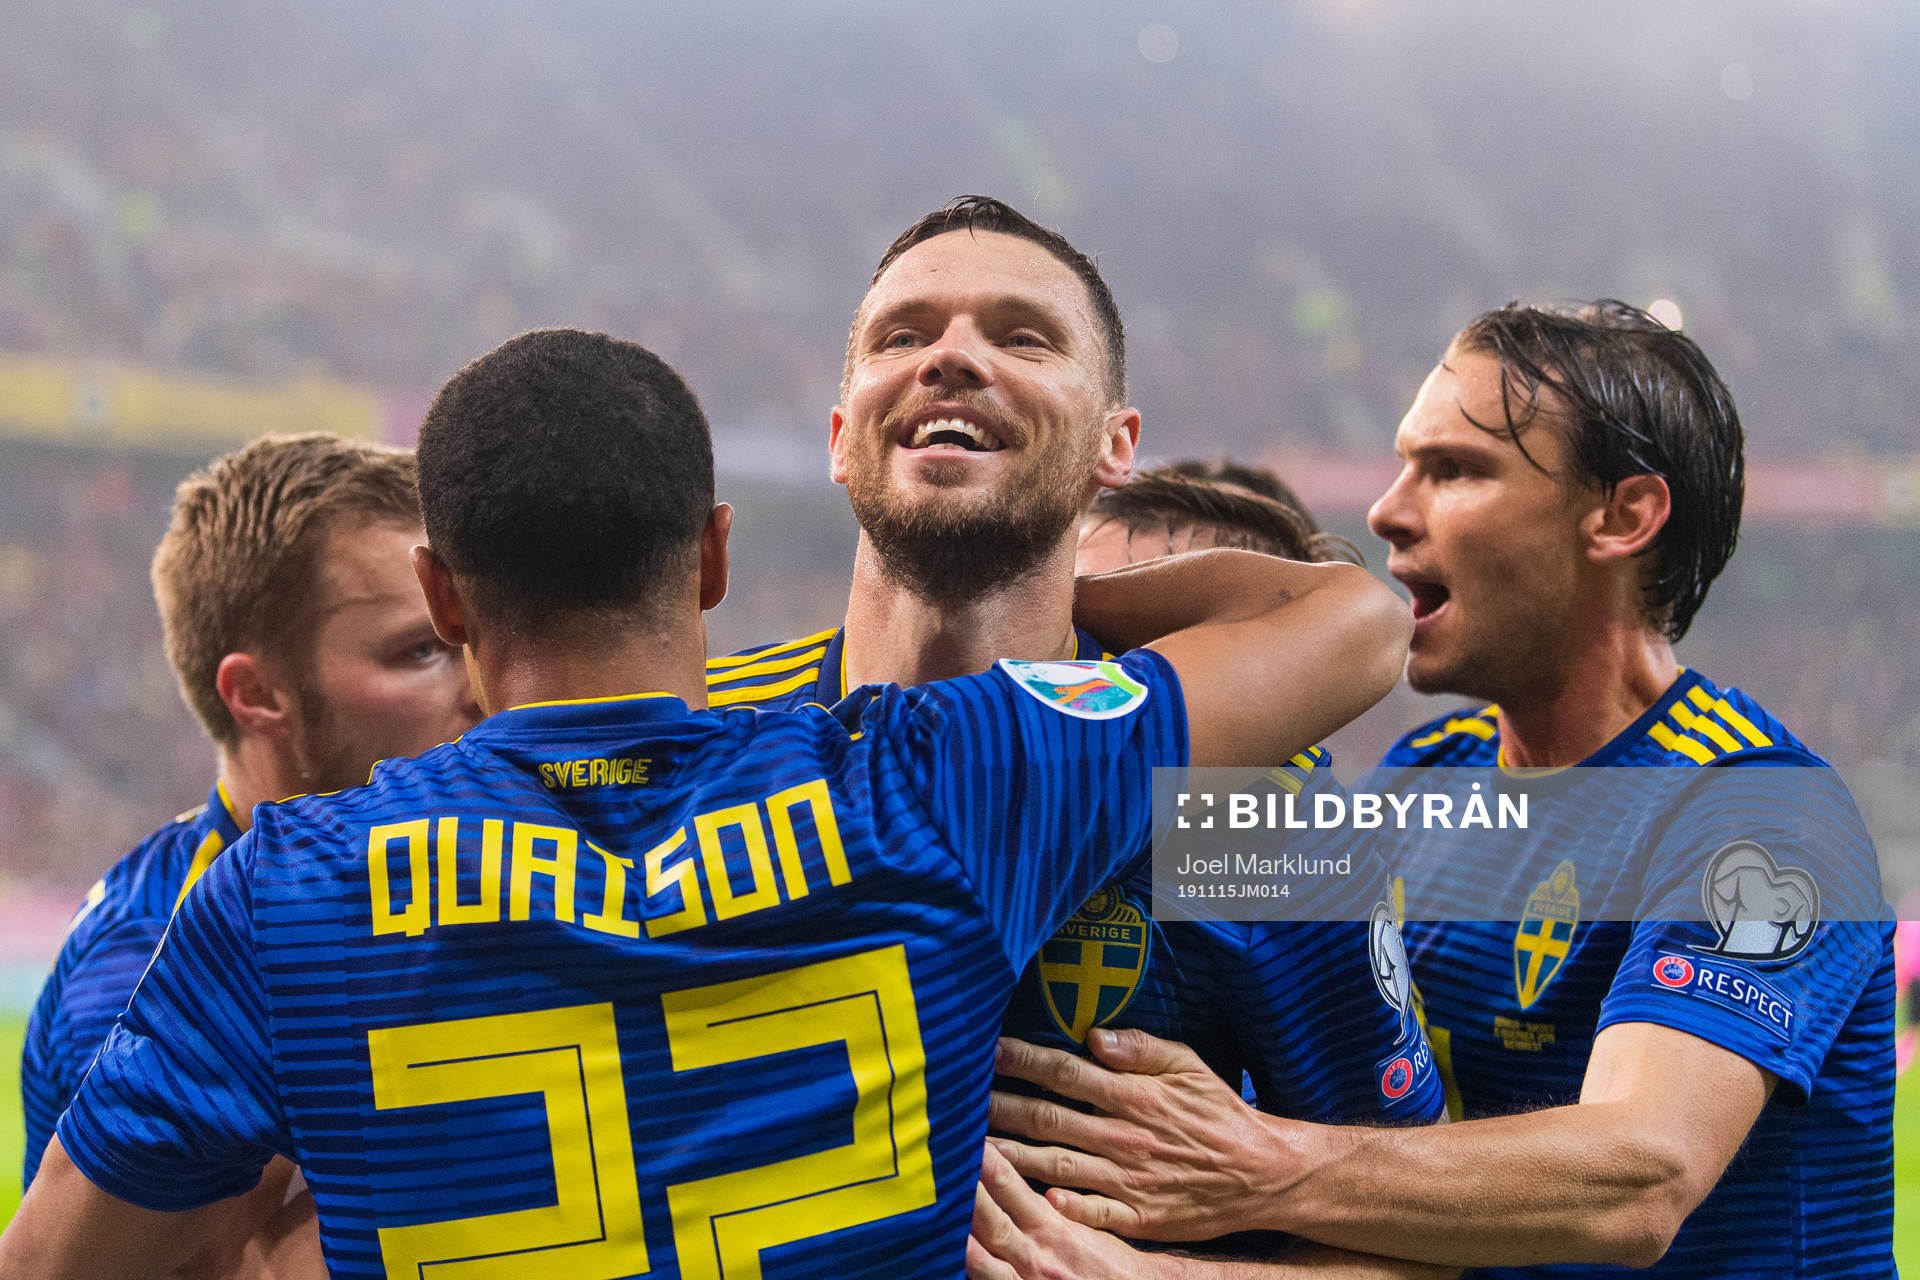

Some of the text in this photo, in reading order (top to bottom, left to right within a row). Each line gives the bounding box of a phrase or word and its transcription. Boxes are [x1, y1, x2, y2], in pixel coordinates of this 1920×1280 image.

[538, 758, 653, 789] SVERIGE
[367, 778, 853, 939] QUAISON
[1697, 968, 1794, 1029] RESPECT
[367, 943, 938, 1280] 22
